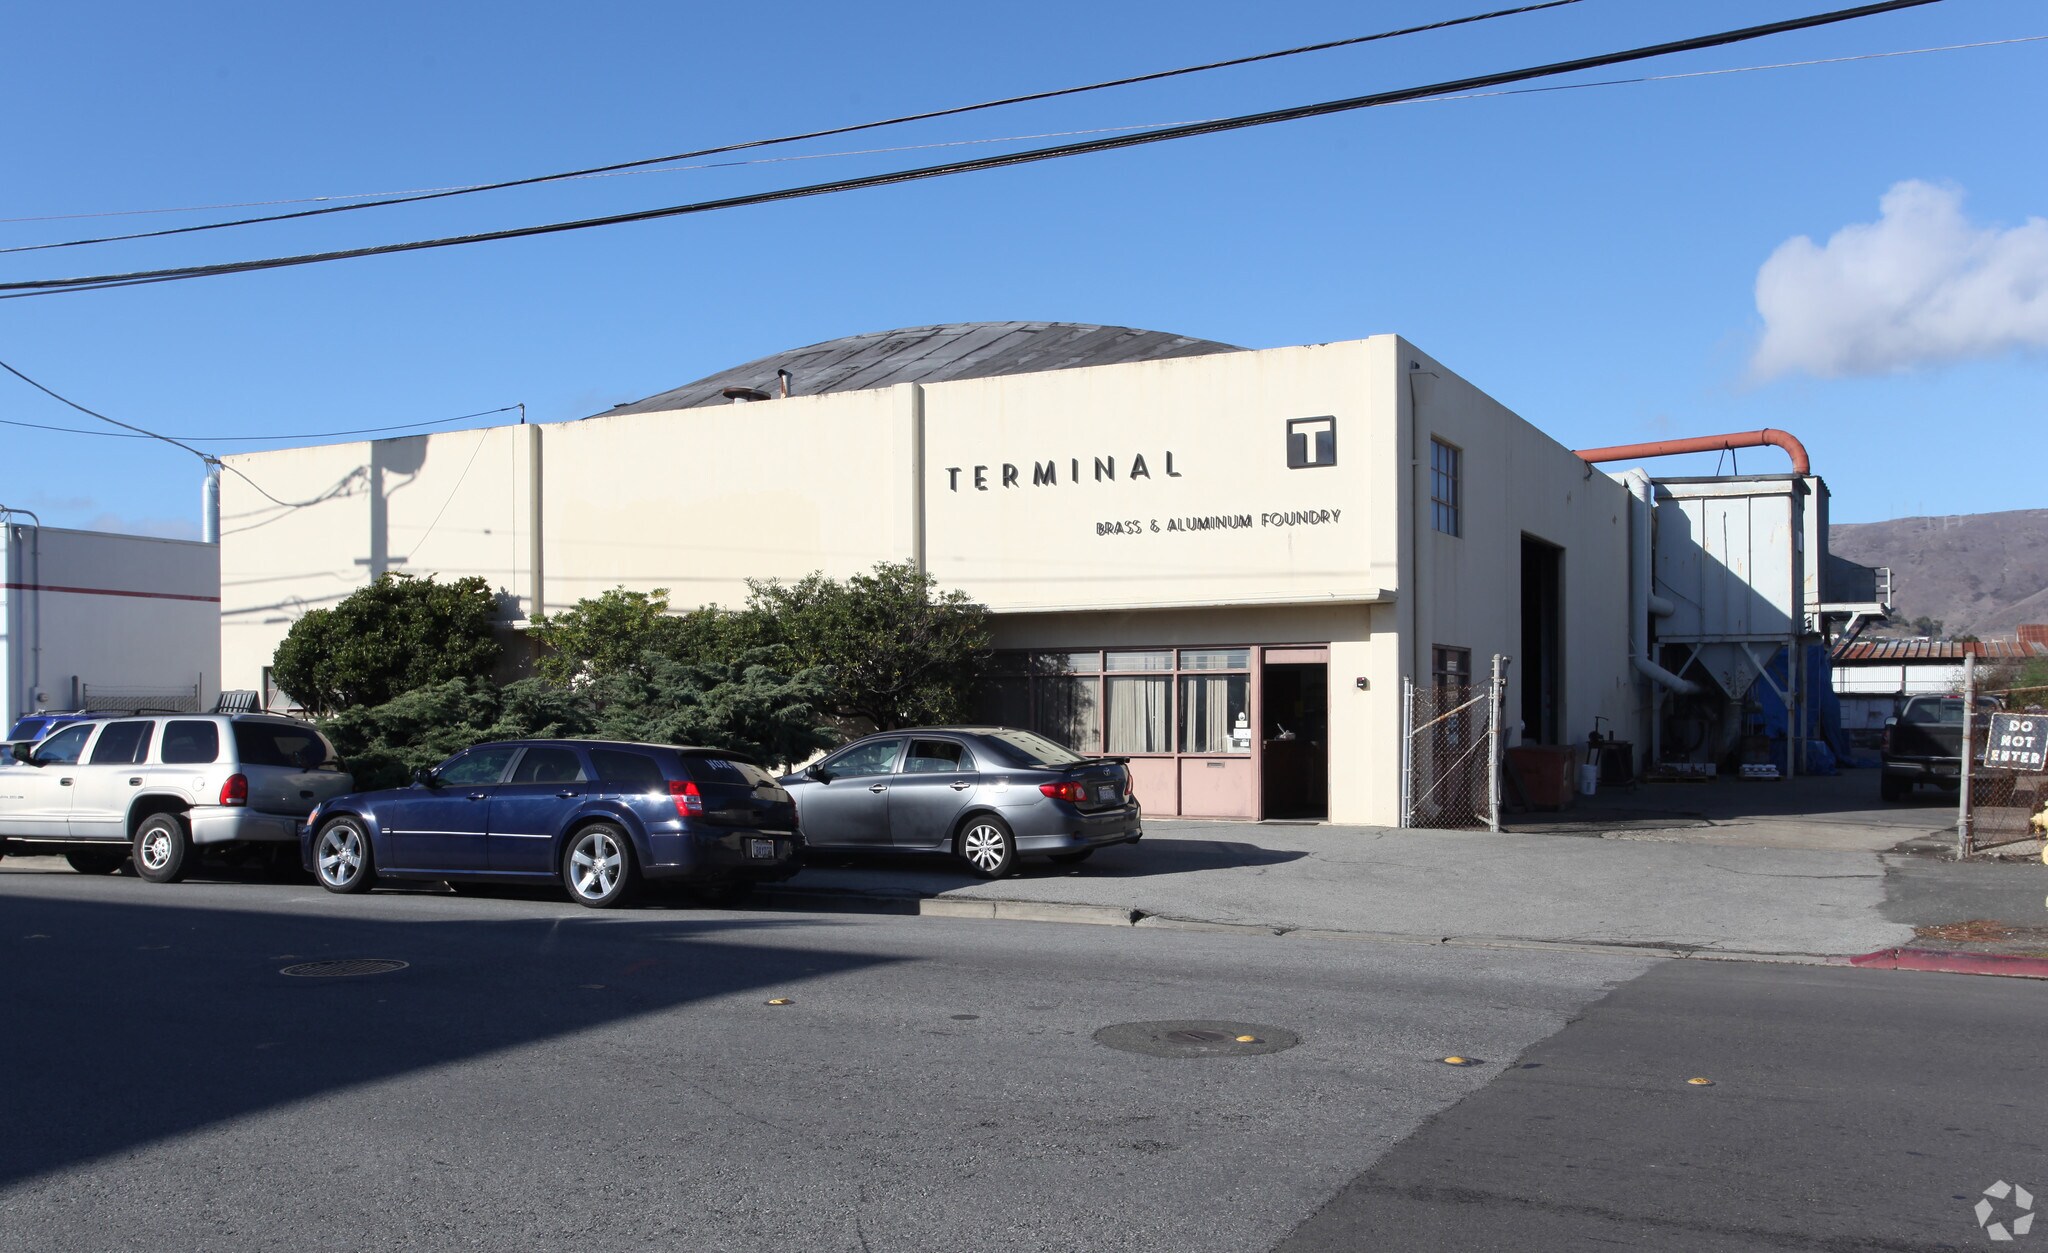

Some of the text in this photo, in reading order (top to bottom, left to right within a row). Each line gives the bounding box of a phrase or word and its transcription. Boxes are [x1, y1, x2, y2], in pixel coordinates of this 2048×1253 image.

[1289, 420, 1331, 463] T
[945, 450, 1182, 493] TERMINAL
[1096, 508, 1342, 537] BRASS & ALUMINUM FOUNDRY
[2008, 719, 2034, 733] DO
[2000, 734, 2036, 748] NOT
[1990, 749, 2041, 764] ENTER
